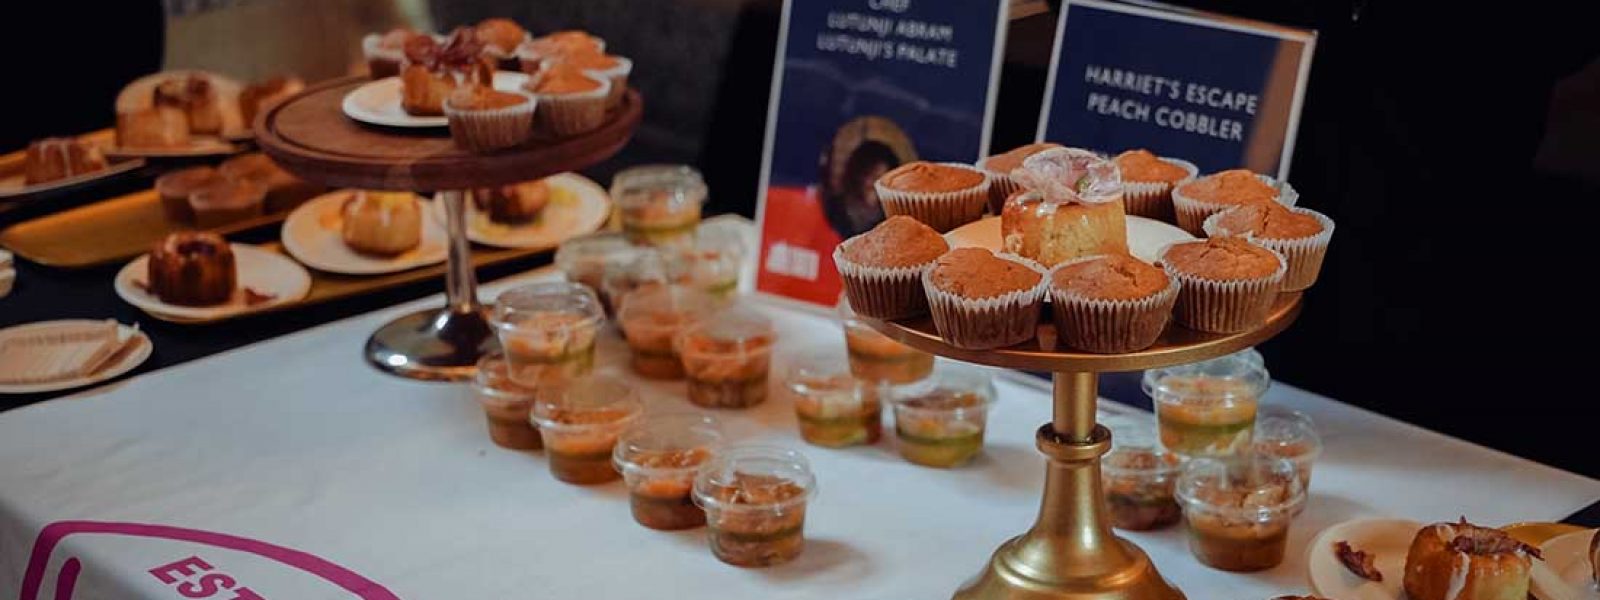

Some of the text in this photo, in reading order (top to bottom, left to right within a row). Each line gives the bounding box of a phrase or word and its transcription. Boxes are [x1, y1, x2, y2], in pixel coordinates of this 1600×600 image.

[896, 43, 957, 68] PALATE
[1085, 65, 1258, 115] HARRIET'S ESCAPE
[1087, 92, 1243, 142] PEACH COBBLER
